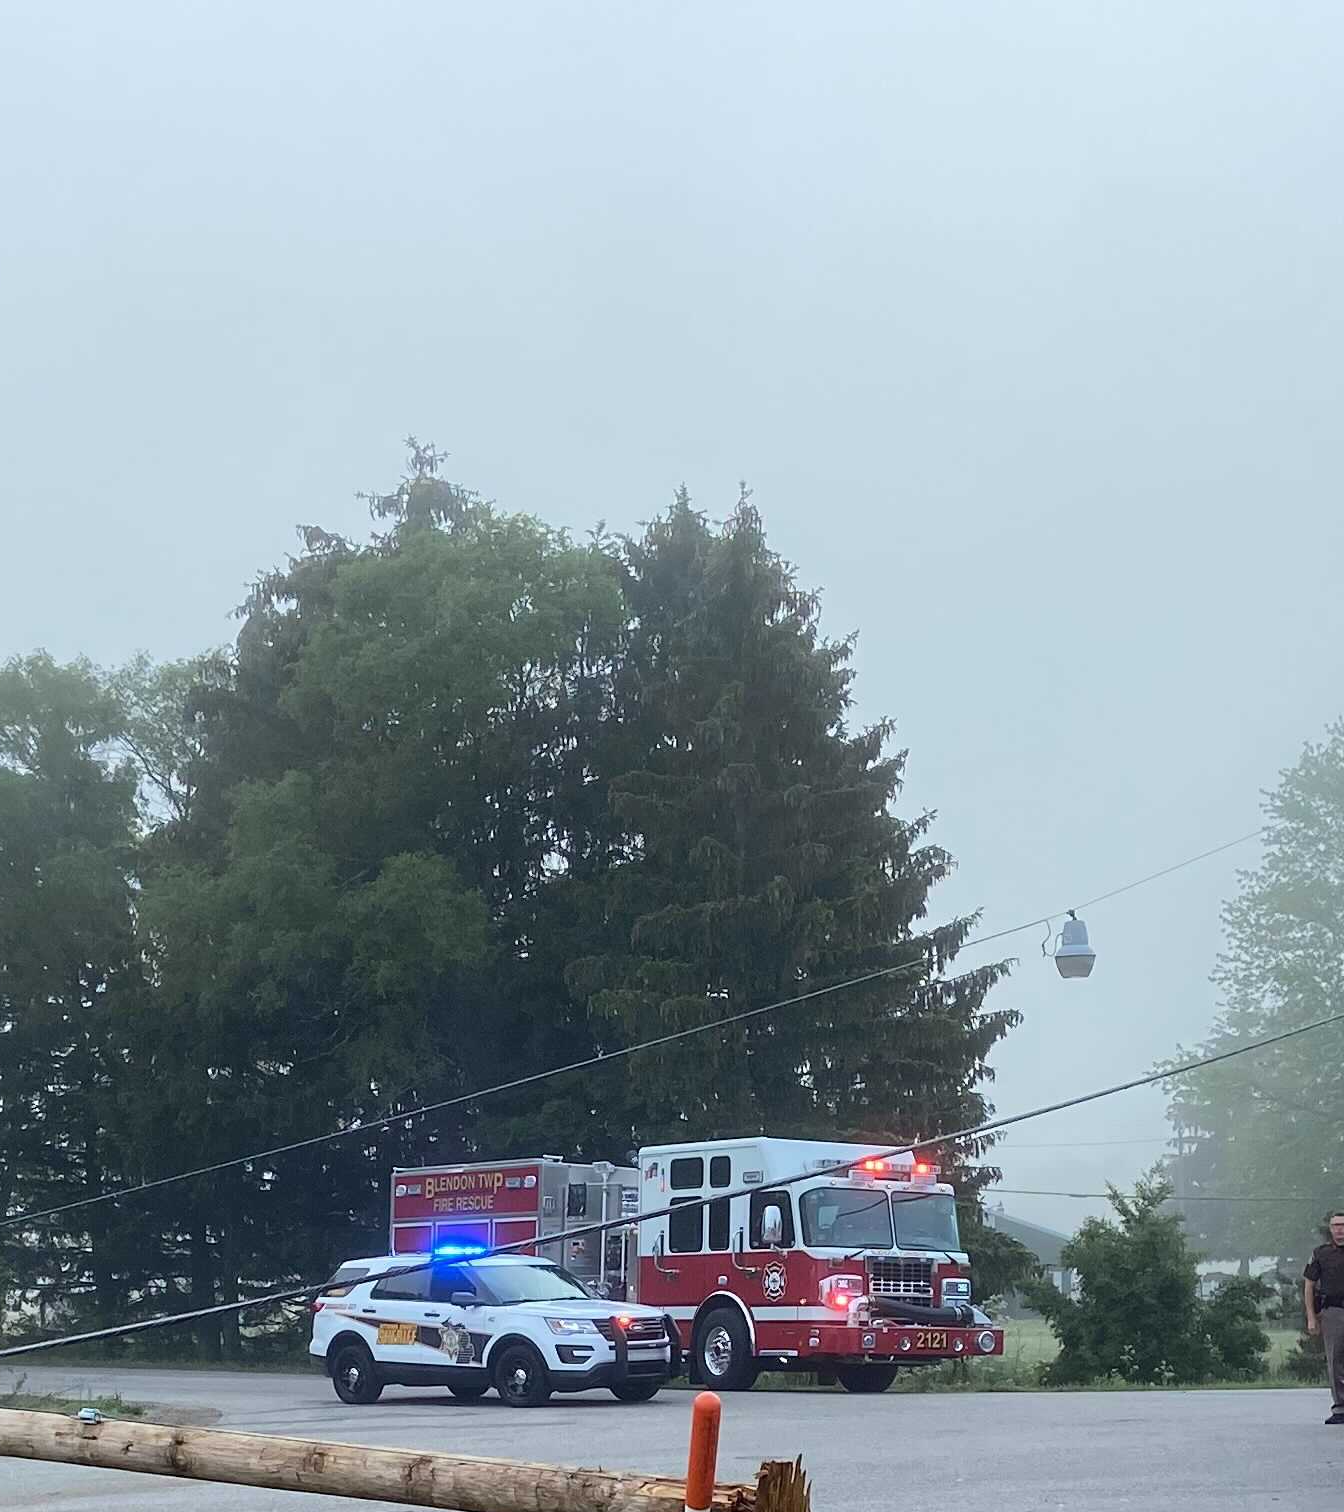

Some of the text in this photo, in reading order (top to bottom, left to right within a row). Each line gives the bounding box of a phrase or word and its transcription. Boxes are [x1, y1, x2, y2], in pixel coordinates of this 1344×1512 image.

[425, 1173, 503, 1198] BLENDON TWP
[433, 1195, 494, 1212] FIRE RESCUE
[916, 1331, 948, 1349] 2121
